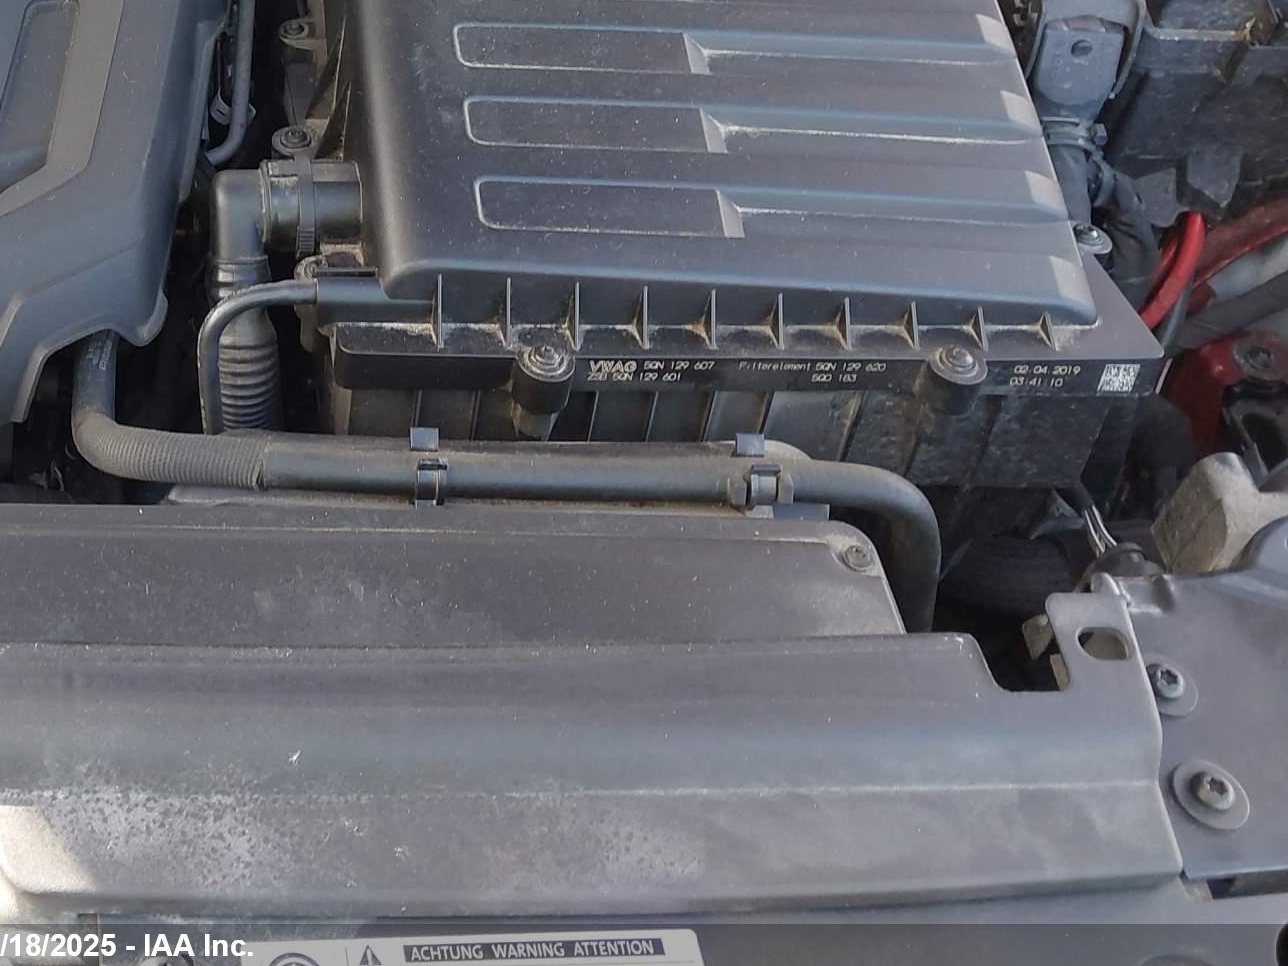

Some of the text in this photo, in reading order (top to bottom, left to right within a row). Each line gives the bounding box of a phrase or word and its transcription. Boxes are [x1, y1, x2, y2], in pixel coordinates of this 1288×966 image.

[671, 361, 690, 371] 129
[693, 361, 715, 371] 607
[738, 361, 811, 371] Filterelement
[842, 362, 862, 372] 129
[865, 363, 887, 372] 620
[639, 373, 659, 382] 129
[662, 373, 681, 382] 601
[411, 939, 654, 961] ACHTUNG WARNING ATTENTION
